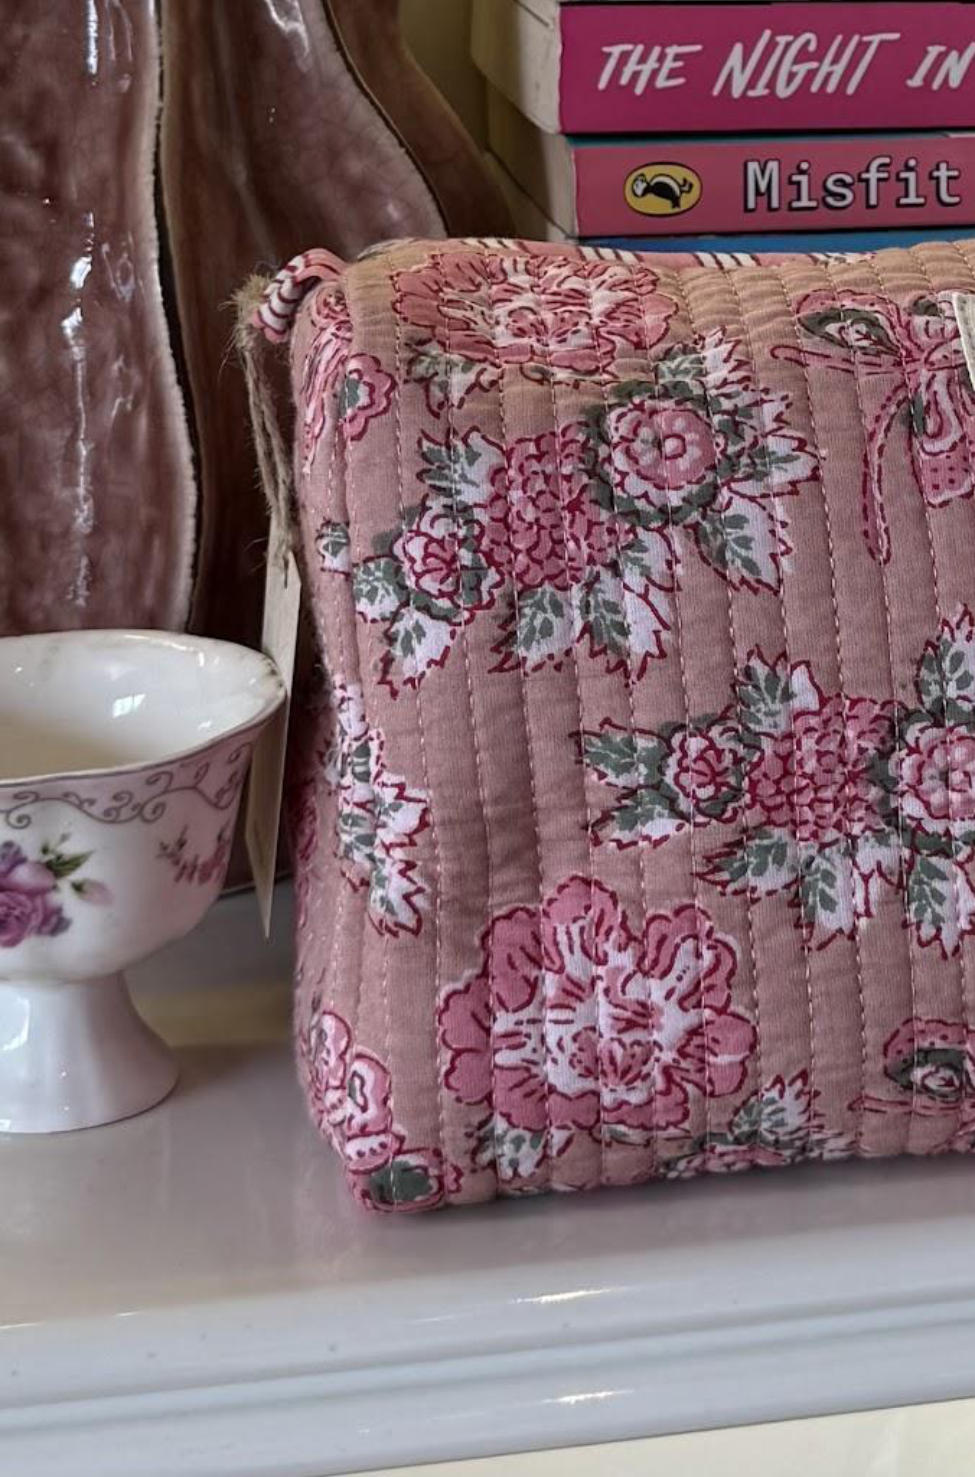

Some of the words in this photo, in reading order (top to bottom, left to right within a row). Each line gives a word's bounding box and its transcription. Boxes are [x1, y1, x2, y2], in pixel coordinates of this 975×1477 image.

[597, 43, 703, 96] THE
[712, 28, 901, 100] NIGHT
[743, 155, 962, 213] Misfit
